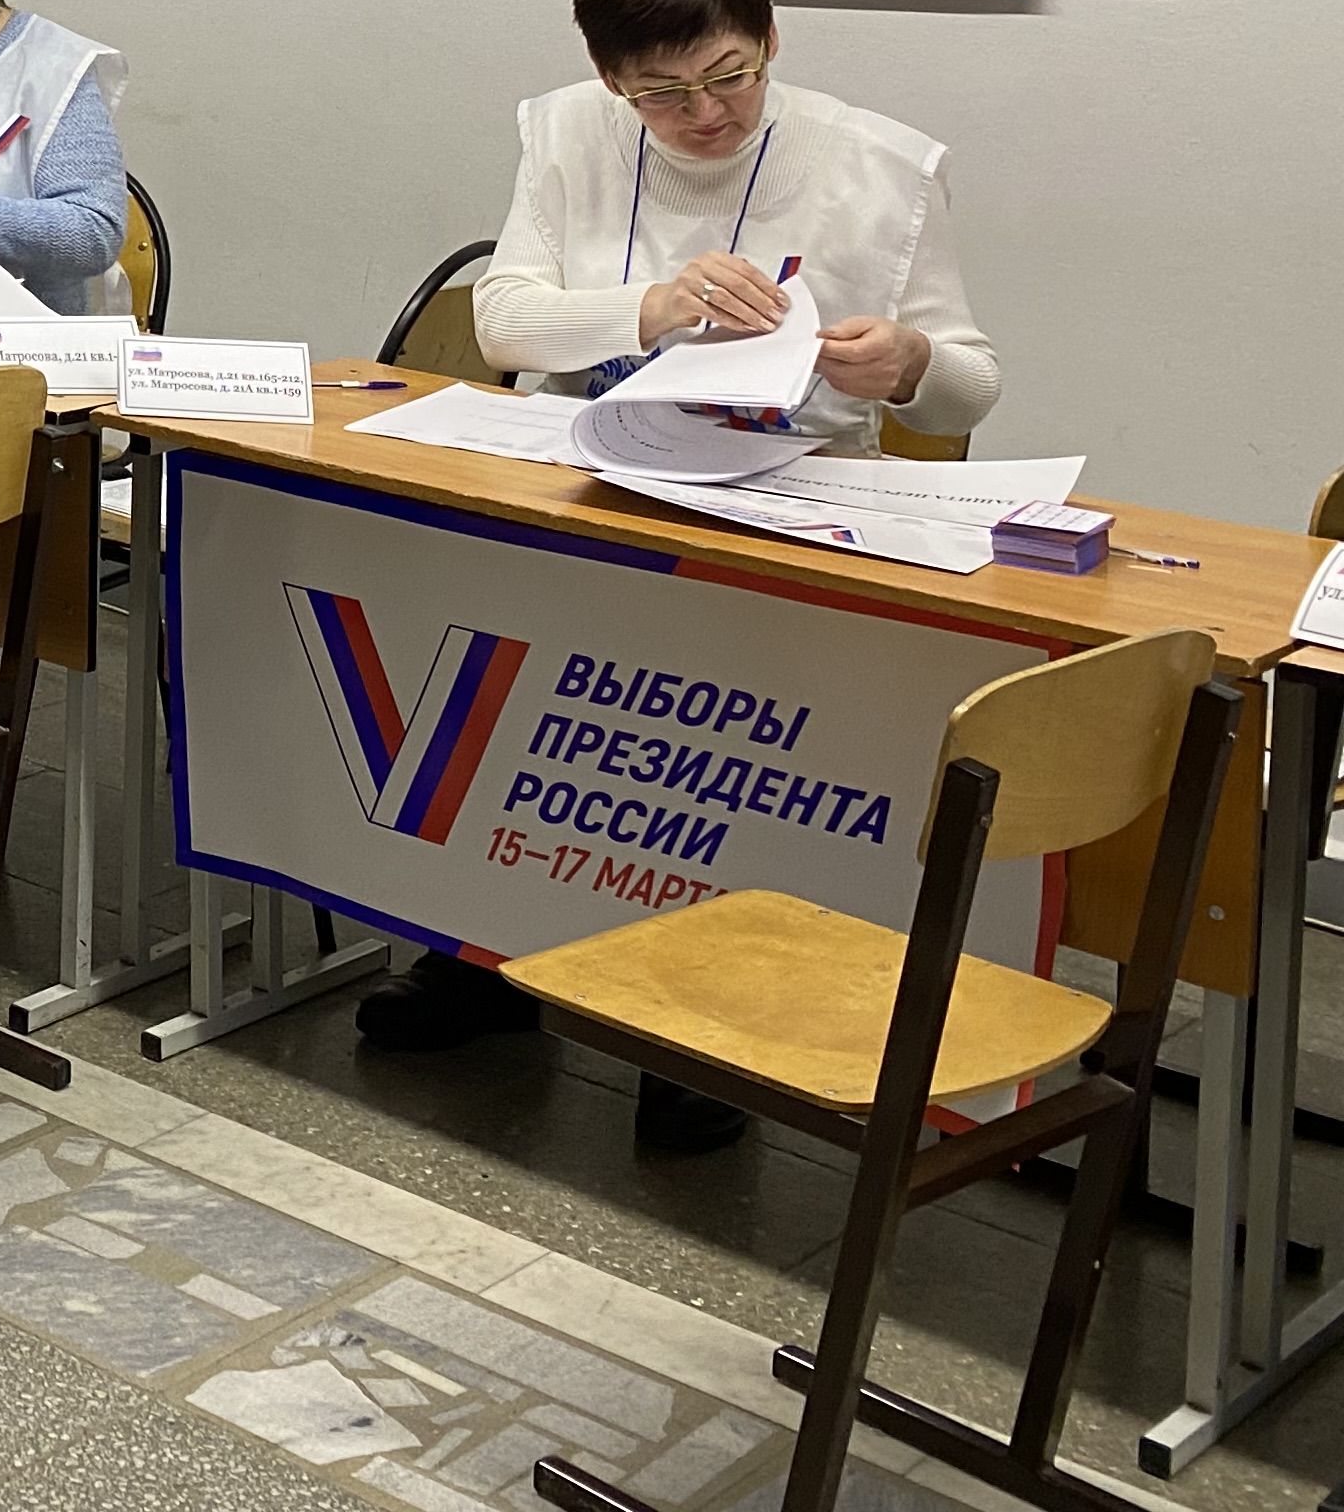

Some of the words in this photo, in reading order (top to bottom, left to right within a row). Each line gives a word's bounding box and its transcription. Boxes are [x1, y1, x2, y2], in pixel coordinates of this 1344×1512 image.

[64, 352, 88, 363] д.21
[128, 368, 145, 377] ул.
[148, 367, 213, 380] Матросова,
[216, 372, 239, 381] д.21
[131, 380, 149, 389] ул.
[151, 379, 217, 392] Матросова,
[256, 387, 302, 397] кв.1-159
[554, 652, 811, 752] ВЫБОРЫ
[528, 712, 892, 845] ПРЕЗИДЕНТА
[503, 771, 729, 867] РОССИИ
